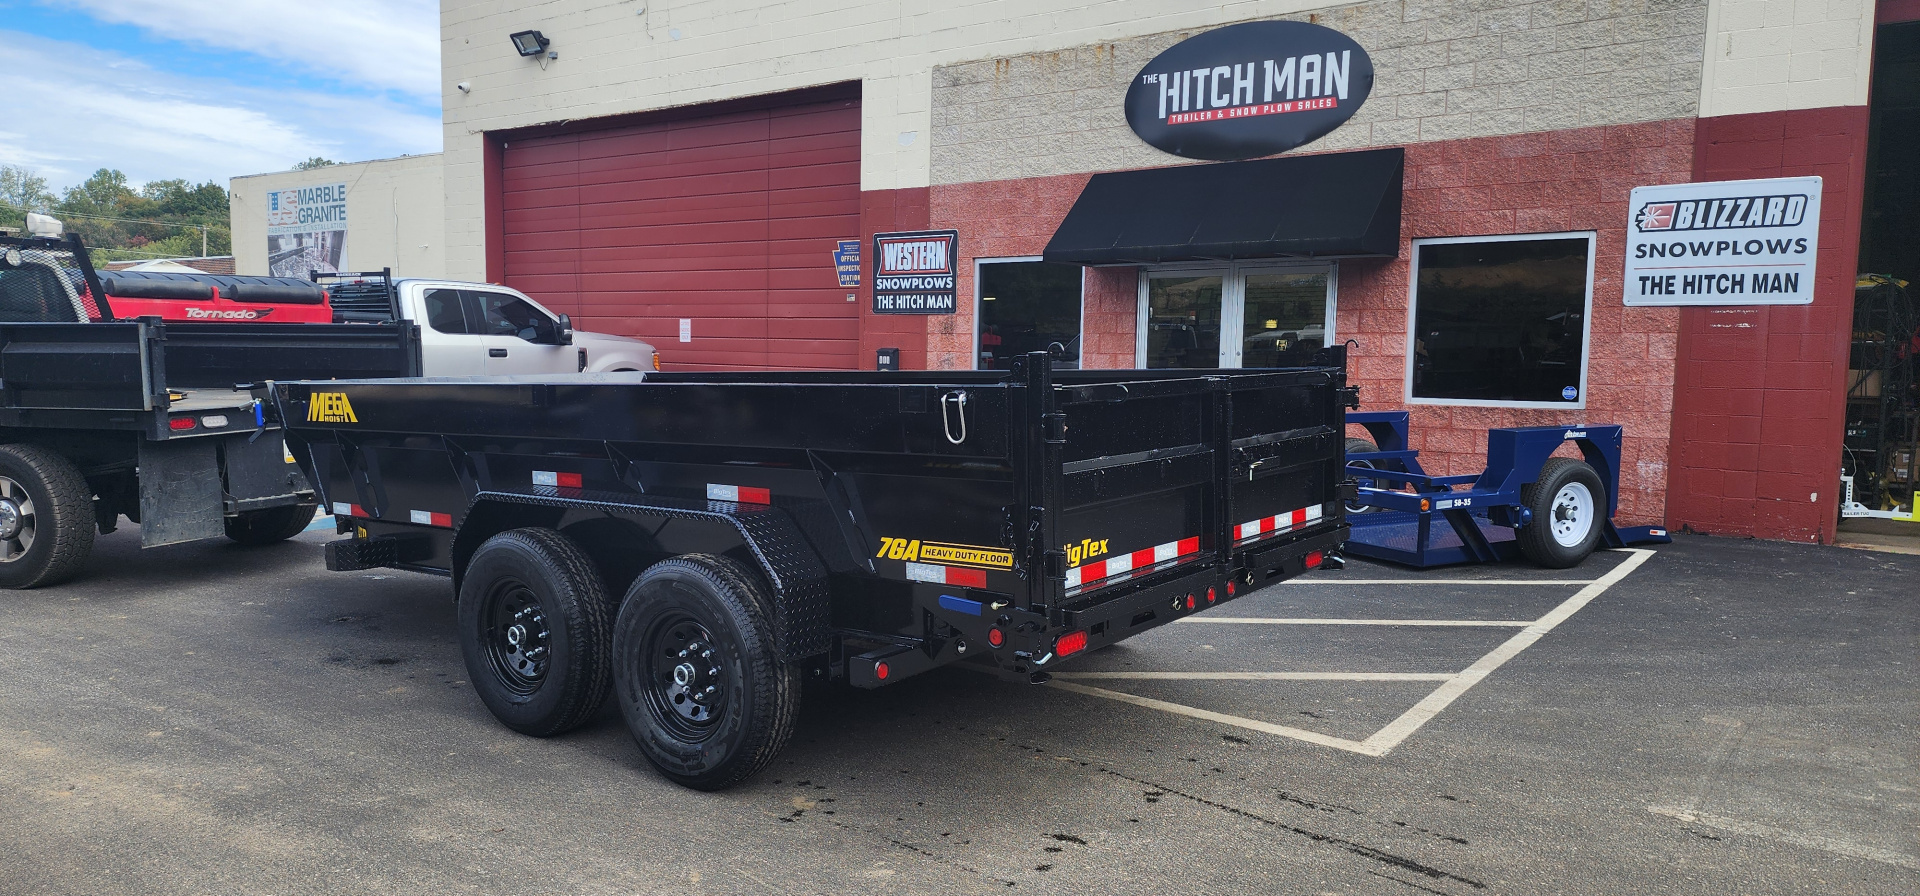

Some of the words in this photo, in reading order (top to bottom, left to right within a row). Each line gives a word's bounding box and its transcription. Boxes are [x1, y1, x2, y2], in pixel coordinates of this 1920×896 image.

[1142, 73, 1158, 85] THE
[1158, 62, 1255, 119] HITCH
[1263, 50, 1350, 102] MAN
[1171, 110, 1211, 123] TRAILER
[1217, 109, 1224, 118] &
[1229, 106, 1258, 117] SNOW
[1263, 102, 1292, 113] PLOW
[1297, 98, 1332, 110] SALES
[297, 185, 346, 205] MARBLE
[298, 203, 346, 223] GRANITE
[1674, 195, 1807, 230] BLIZZARD
[268, 225, 300, 234] FABRICATION
[309, 221, 347, 231] INSTALLATION
[840, 255, 860, 263] OFFICIA
[884, 240, 946, 271] WESTERN
[1634, 237, 1808, 259] SNOWPLOWS
[876, 277, 953, 290] SNOWPLOWS
[1638, 275, 1676, 295] THE
[1682, 273, 1745, 295] HITCH
[1752, 272, 1799, 294] MAN
[877, 295, 894, 309] THE
[896, 295, 924, 309] HITCH
[927, 294, 952, 308] MAN
[185, 307, 257, 319] Tornado
[307, 392, 359, 423] MEGA
[324, 415, 345, 423] HOIST
[876, 536, 920, 561] 7GA
[925, 548, 954, 558] HEAVY
[955, 551, 978, 561] DUTY
[979, 553, 1009, 564] FLOOR
[1063, 538, 1109, 568] igTex
